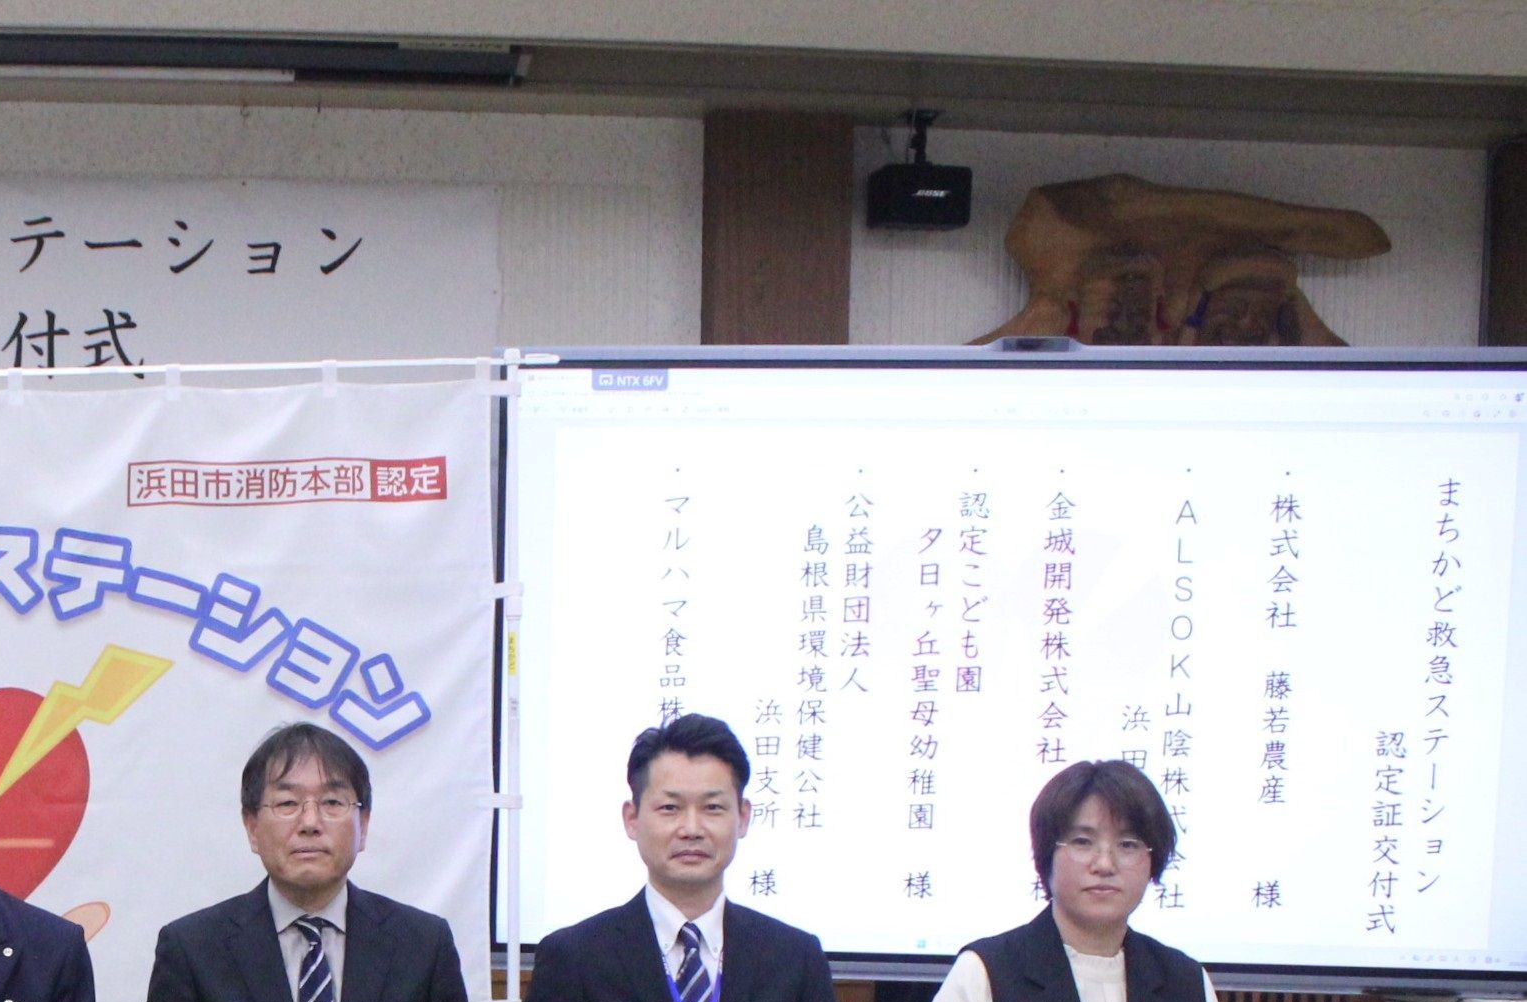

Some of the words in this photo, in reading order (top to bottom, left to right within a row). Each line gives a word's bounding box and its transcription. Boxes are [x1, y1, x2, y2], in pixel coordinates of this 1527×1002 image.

[136, 464, 364, 499] 浜田市消防本部
[376, 464, 441, 496] 認定
[792, 524, 830, 829] 島根県環境保健公社
[1258, 670, 1293, 805] 藤若農産
[1416, 477, 1463, 894] まちかど救急ステーション
[751, 698, 783, 830] 浜田支所
[749, 868, 777, 897] 様
[904, 870, 933, 899] 様
[1252, 879, 1282, 909] 様
[1366, 731, 1407, 935] 認定証交付式
